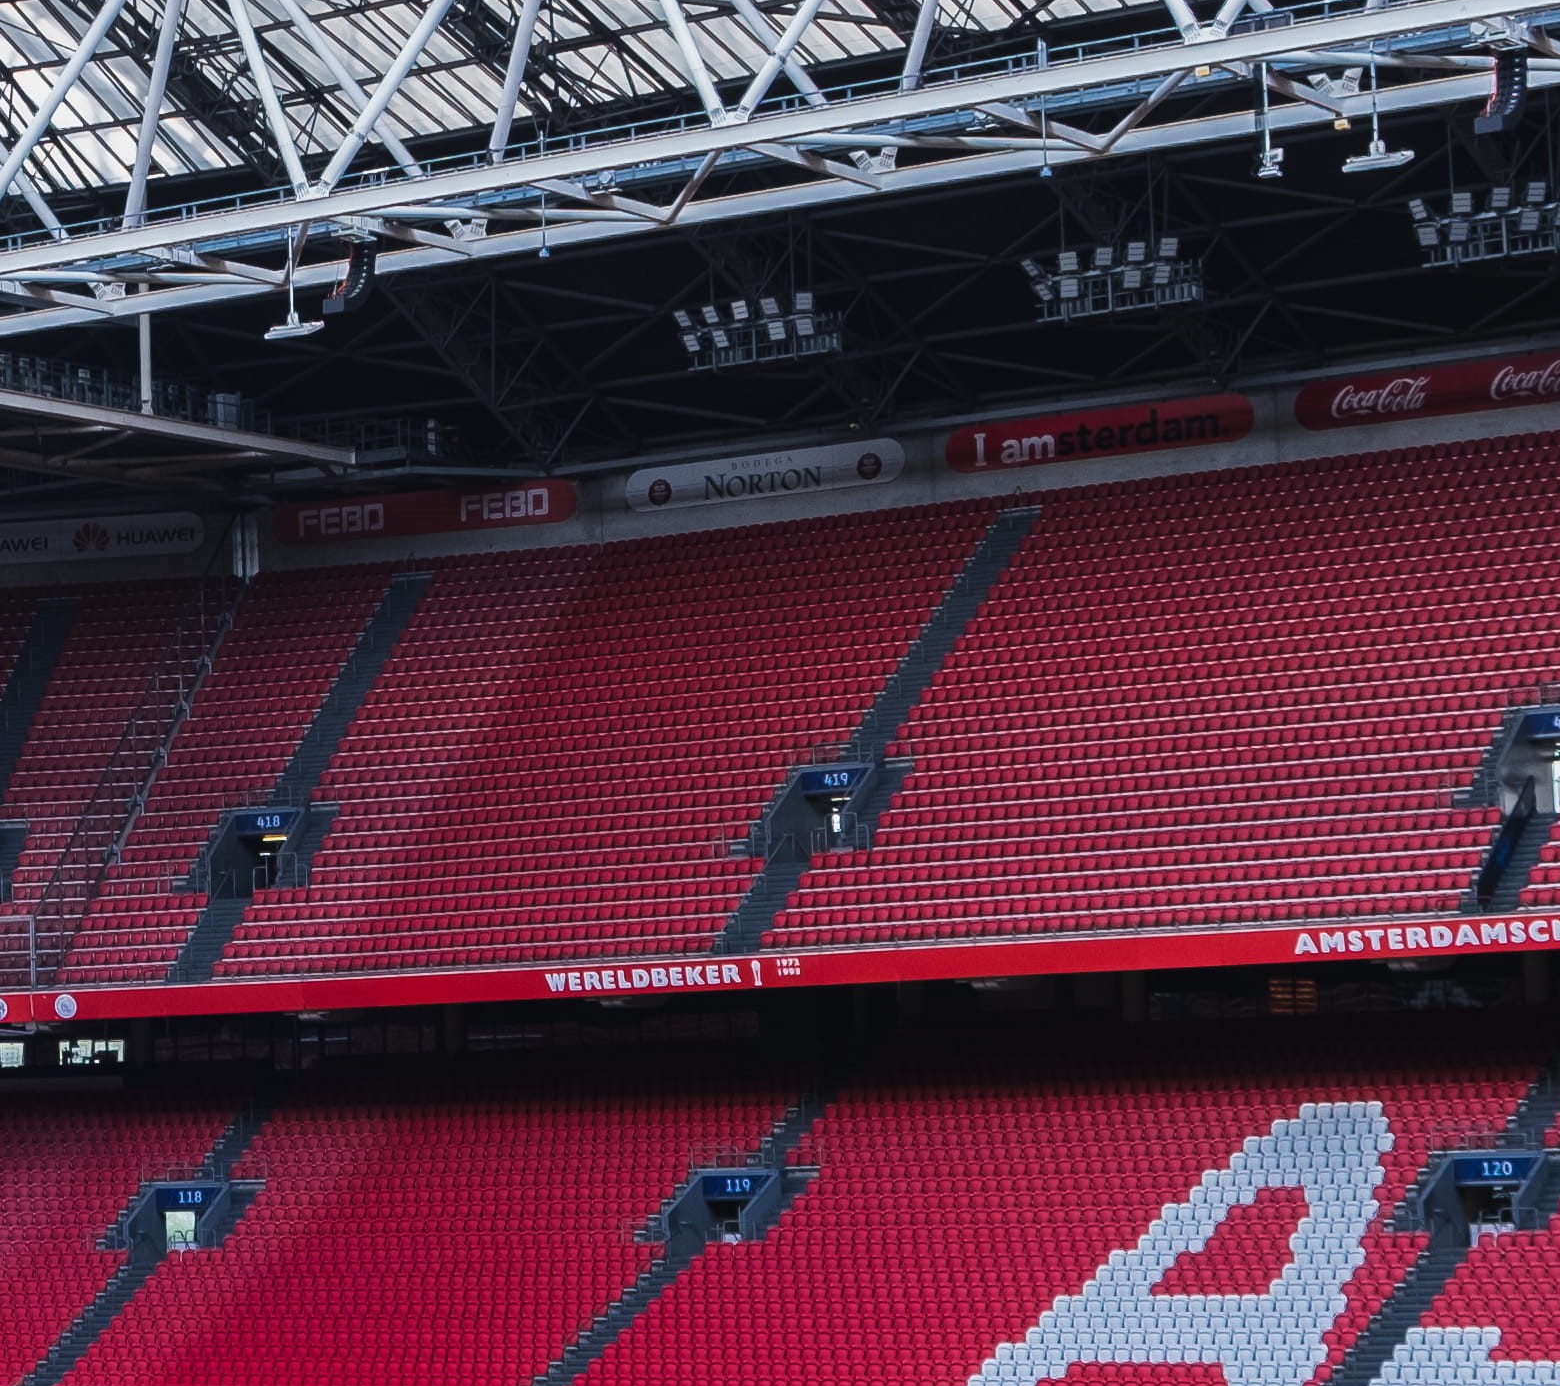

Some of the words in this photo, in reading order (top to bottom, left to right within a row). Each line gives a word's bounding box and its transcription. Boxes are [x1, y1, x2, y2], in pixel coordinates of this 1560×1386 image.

[974, 433, 987, 467] I
[731, 455, 794, 471] BODEGA
[460, 487, 549, 523] FEBO
[298, 503, 384, 538] FEBO
[116, 526, 195, 546] HUAWEI
[824, 772, 848, 786] 419
[256, 816, 280, 828] 418
[544, 963, 742, 993] WERELDBEKER
[1482, 1161, 1512, 1176] 120
[725, 1179, 750, 1193] 119
[177, 1191, 201, 1204] 118
